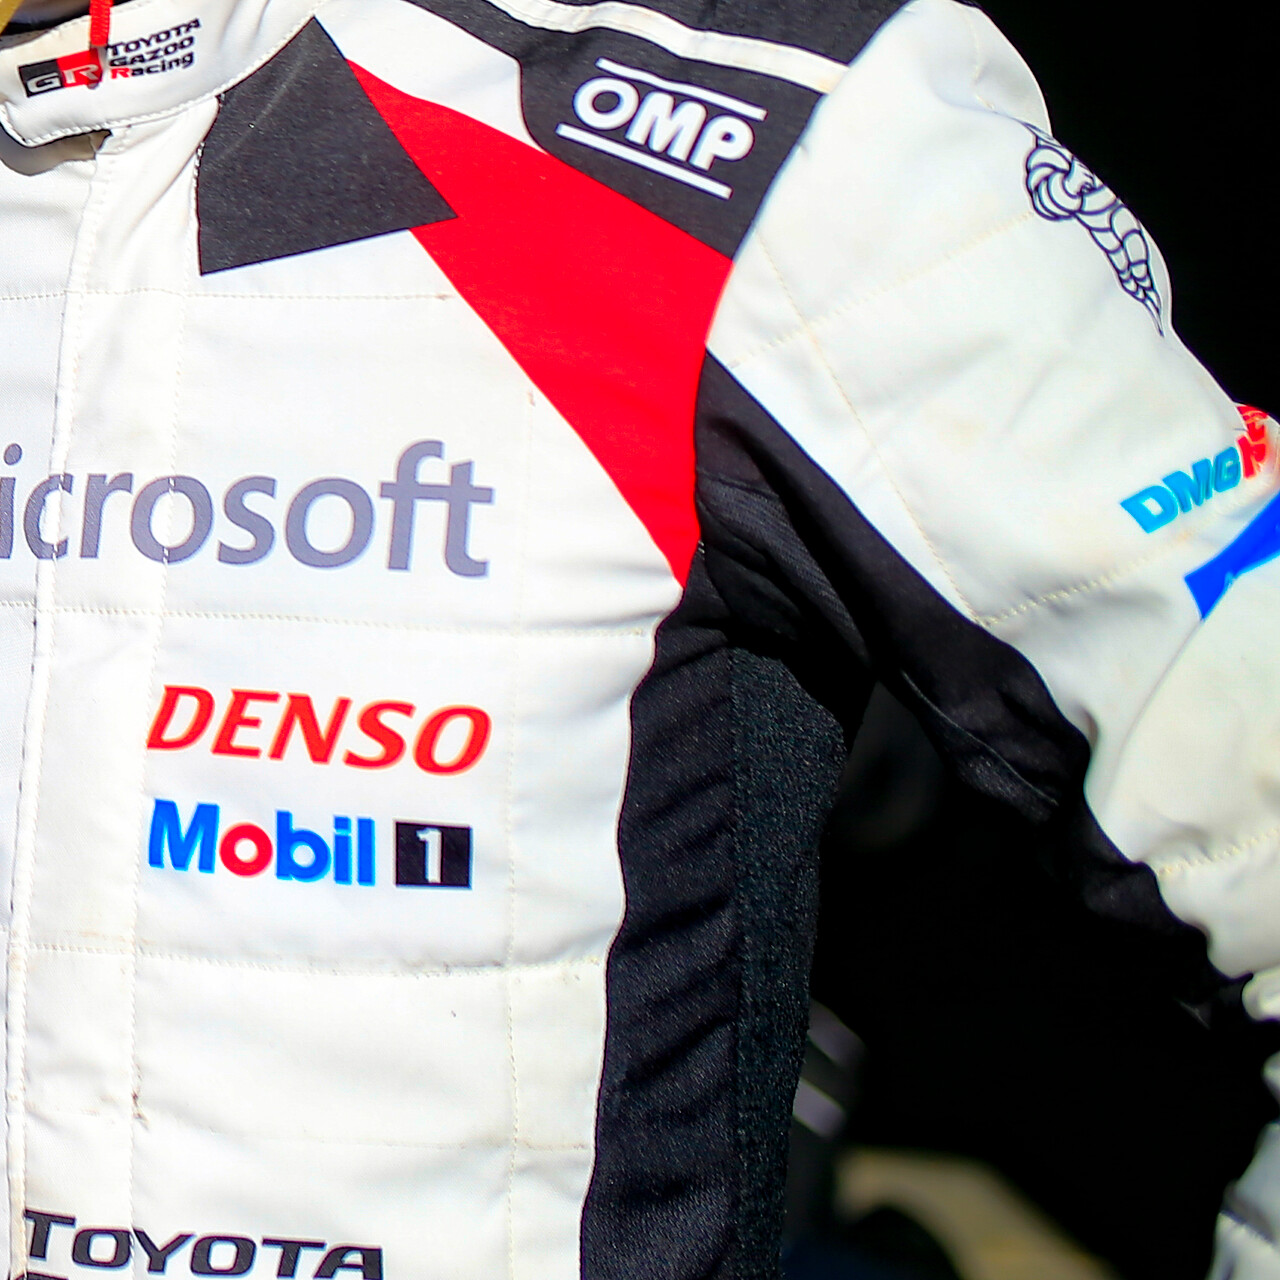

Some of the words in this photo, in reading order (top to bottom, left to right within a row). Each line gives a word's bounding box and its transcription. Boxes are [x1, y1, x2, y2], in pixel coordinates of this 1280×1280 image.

[107, 18, 202, 57] TOYOTA
[108, 36, 195, 67] GAZOO
[111, 51, 195, 79] Racing
[572, 78, 756, 172] OMP
[1120, 447, 1241, 534] DMG
[147, 685, 493, 776] DENSO
[147, 799, 376, 887] Mobil
[23, 1208, 384, 1280] TOYOTA
